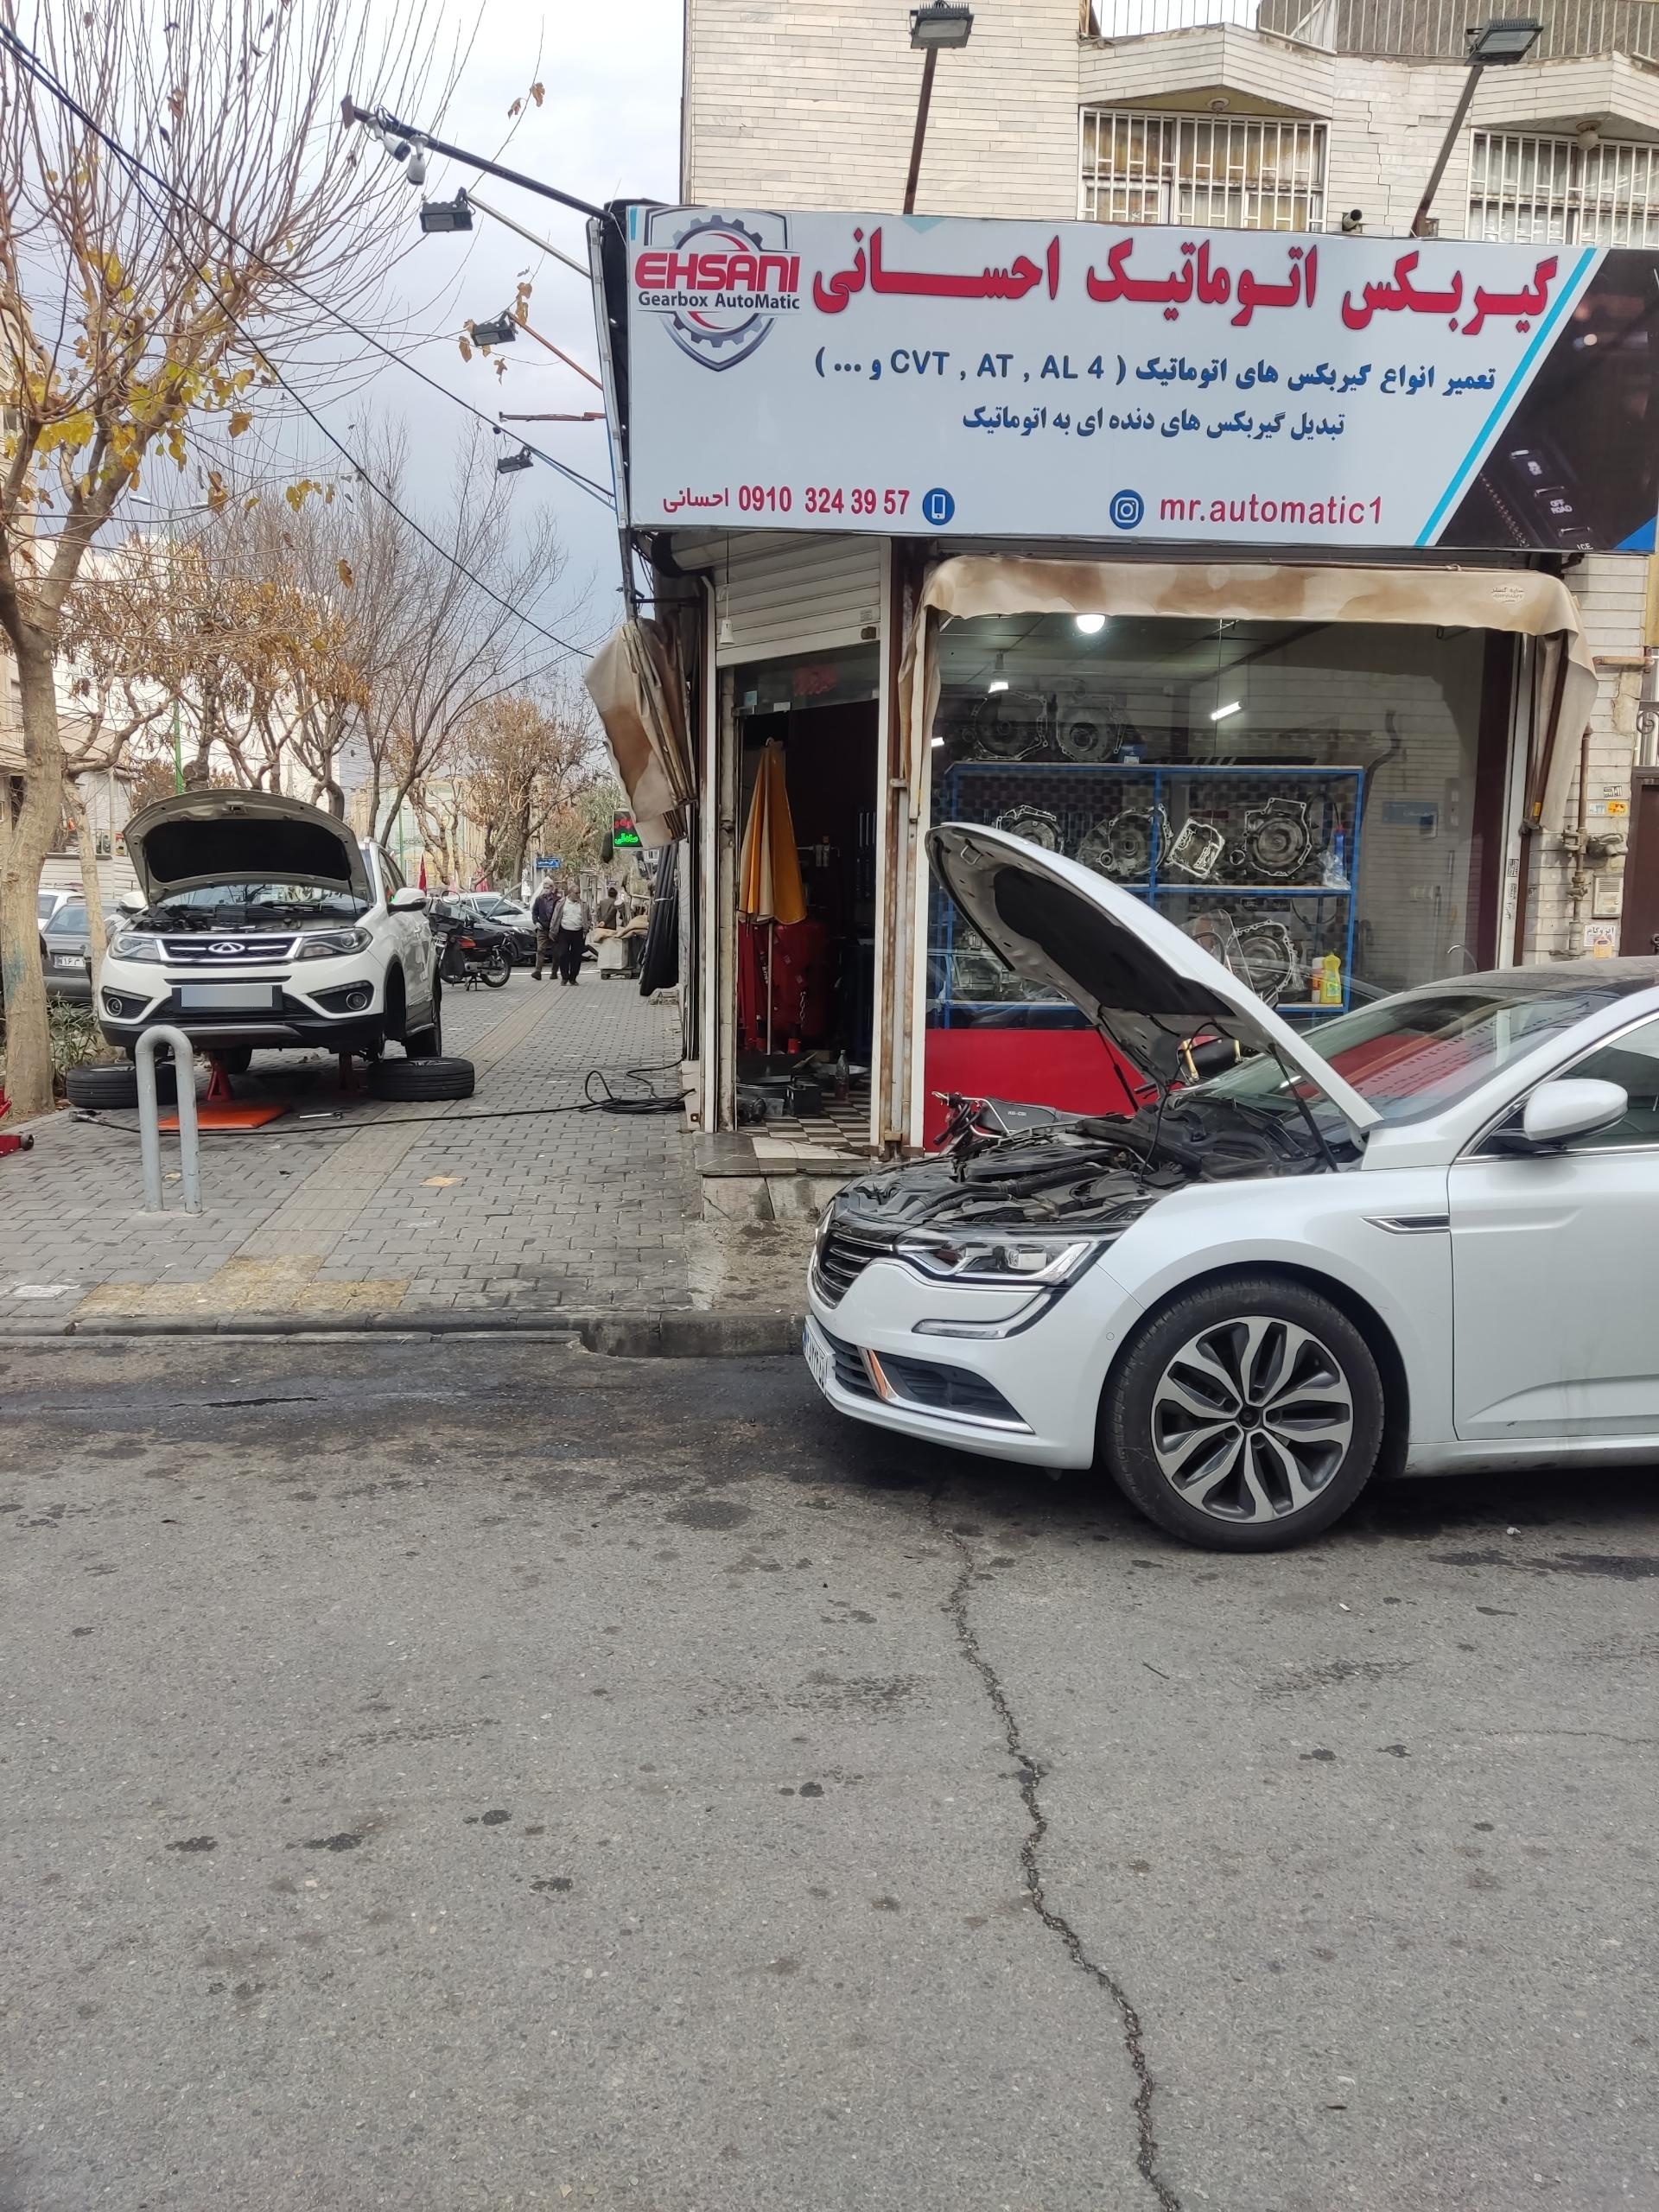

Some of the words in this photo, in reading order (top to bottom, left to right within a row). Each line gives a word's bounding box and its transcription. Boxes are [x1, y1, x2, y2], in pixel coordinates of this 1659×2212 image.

[634, 251, 801, 293] EHSANI
[812, 226, 1059, 314] احسانی
[1086, 238, 1318, 327] اتوماتیک
[638, 290, 709, 308] Gearbox
[715, 292, 800, 310] AutoMatic
[1341, 251, 1559, 336] گیربکس
[890, 348, 951, 376] CVT
[976, 353, 1014, 378] AT
[1040, 354, 1079, 380] AL
[1135, 356, 1228, 391] اتوماتیک
[1235, 358, 1279, 391] های
[1287, 362, 1372, 393] گیربکس
[1380, 365, 1435, 396] انواع
[1442, 366, 1497, 397] تعمیر
[963, 404, 1047, 436] اتوماتیک
[1052, 412, 1071, 437] به
[1076, 406, 1103, 438] ای
[1109, 406, 1155, 431] دنده
[1160, 408, 1201, 439] های
[1206, 410, 1287, 441] گیربکس
[1290, 412, 1346, 442] تبدیل
[663, 487, 730, 513] احسانی
[738, 486, 792, 512] 0910
[1160, 493, 1382, 524] mr.automatic1
